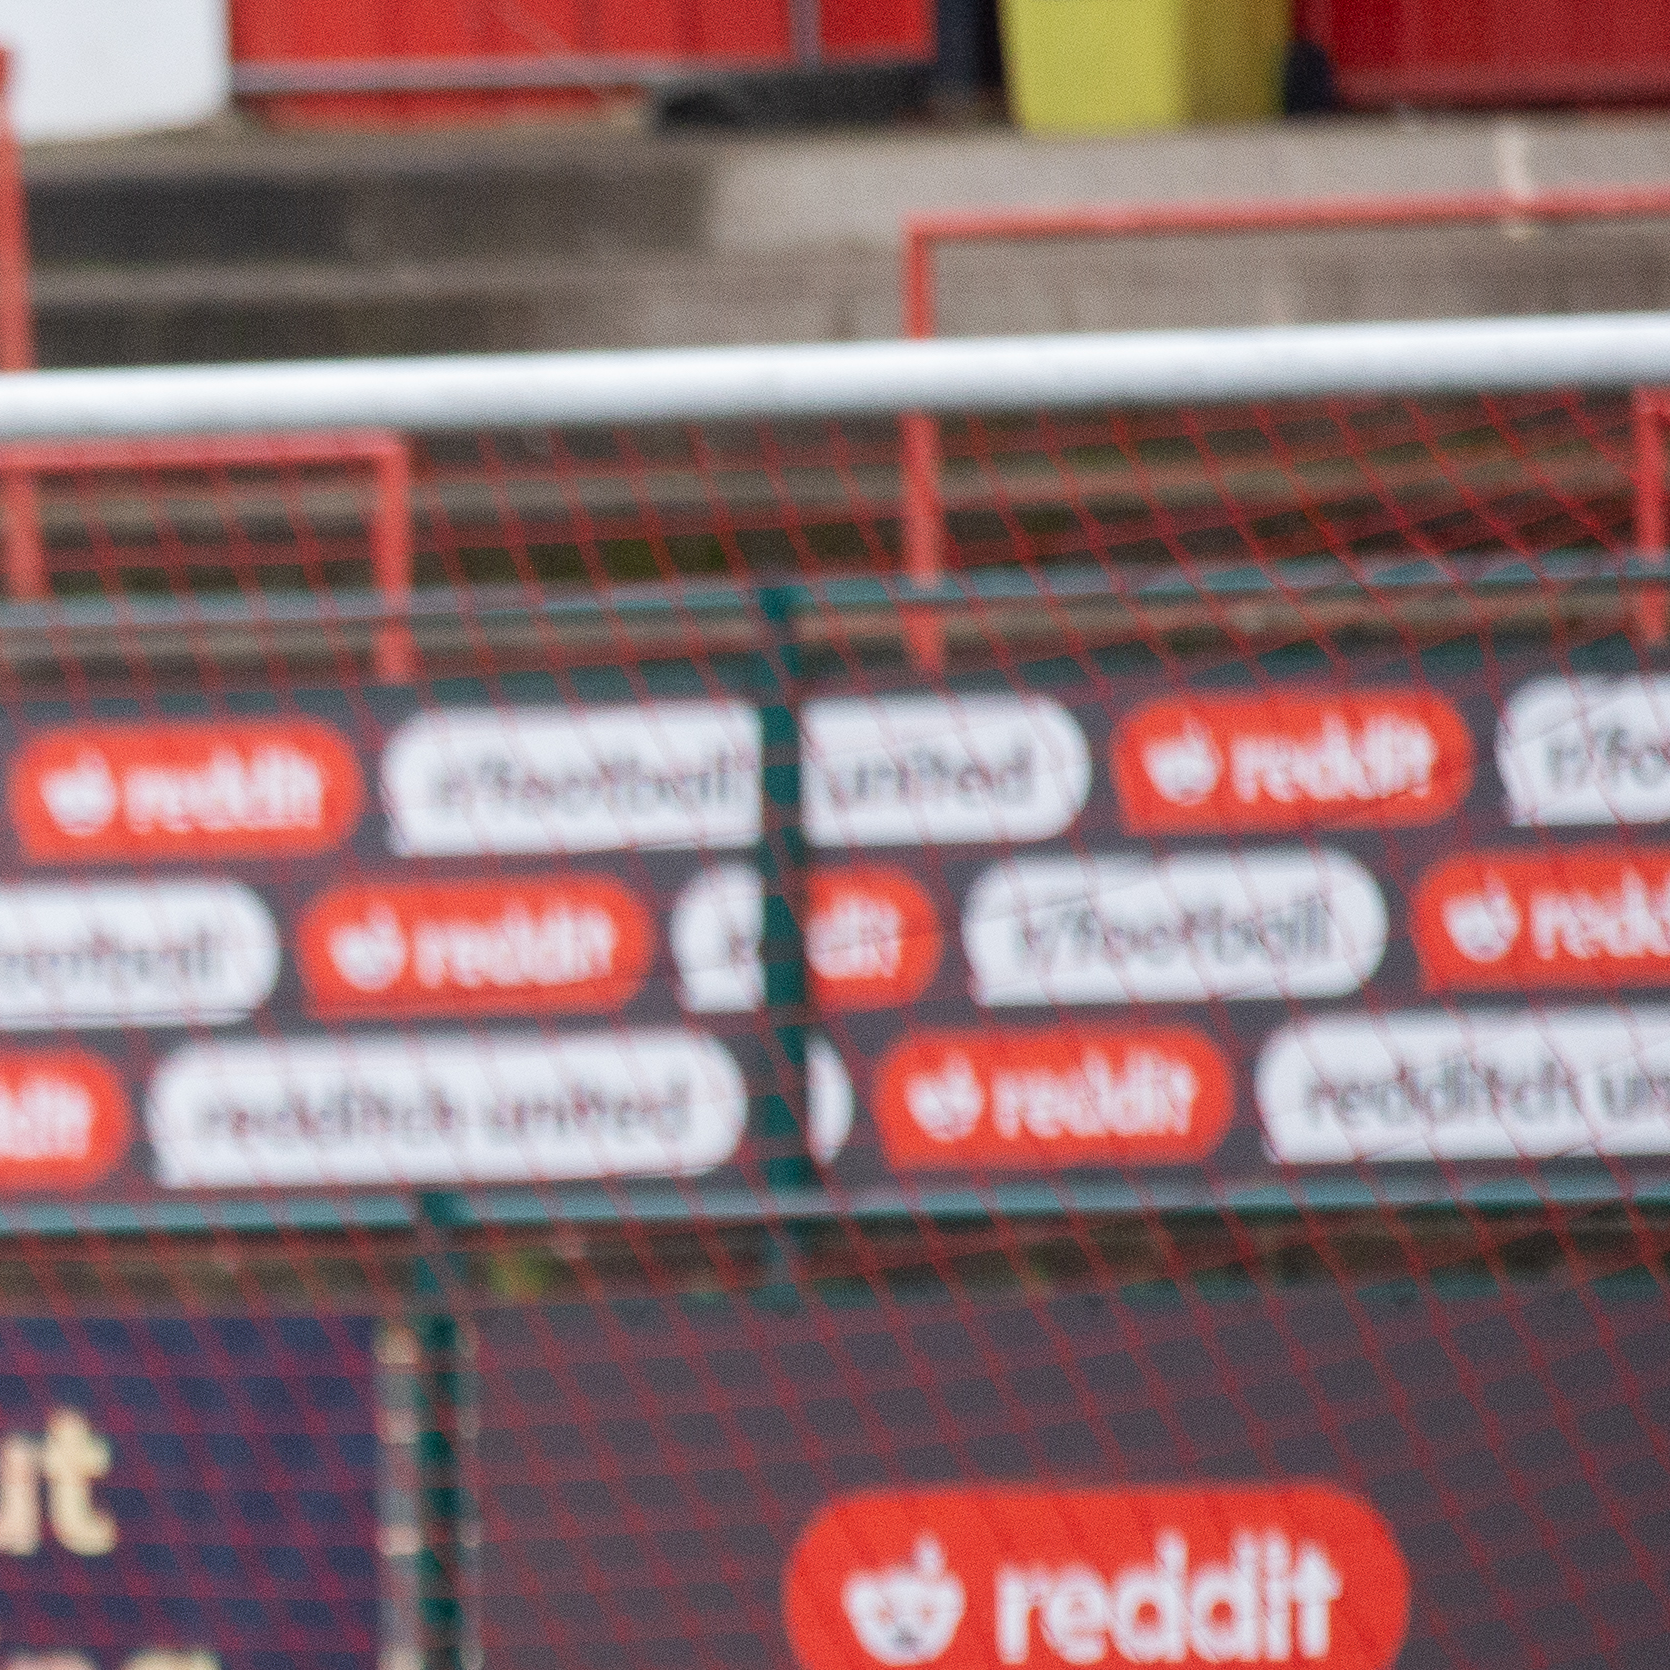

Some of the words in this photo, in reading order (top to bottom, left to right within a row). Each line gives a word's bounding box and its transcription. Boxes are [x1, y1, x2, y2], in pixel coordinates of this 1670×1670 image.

[1230, 712, 1438, 803] reddit
[992, 1050, 1197, 1142] reddit
[994, 1528, 1344, 1666] reddit
